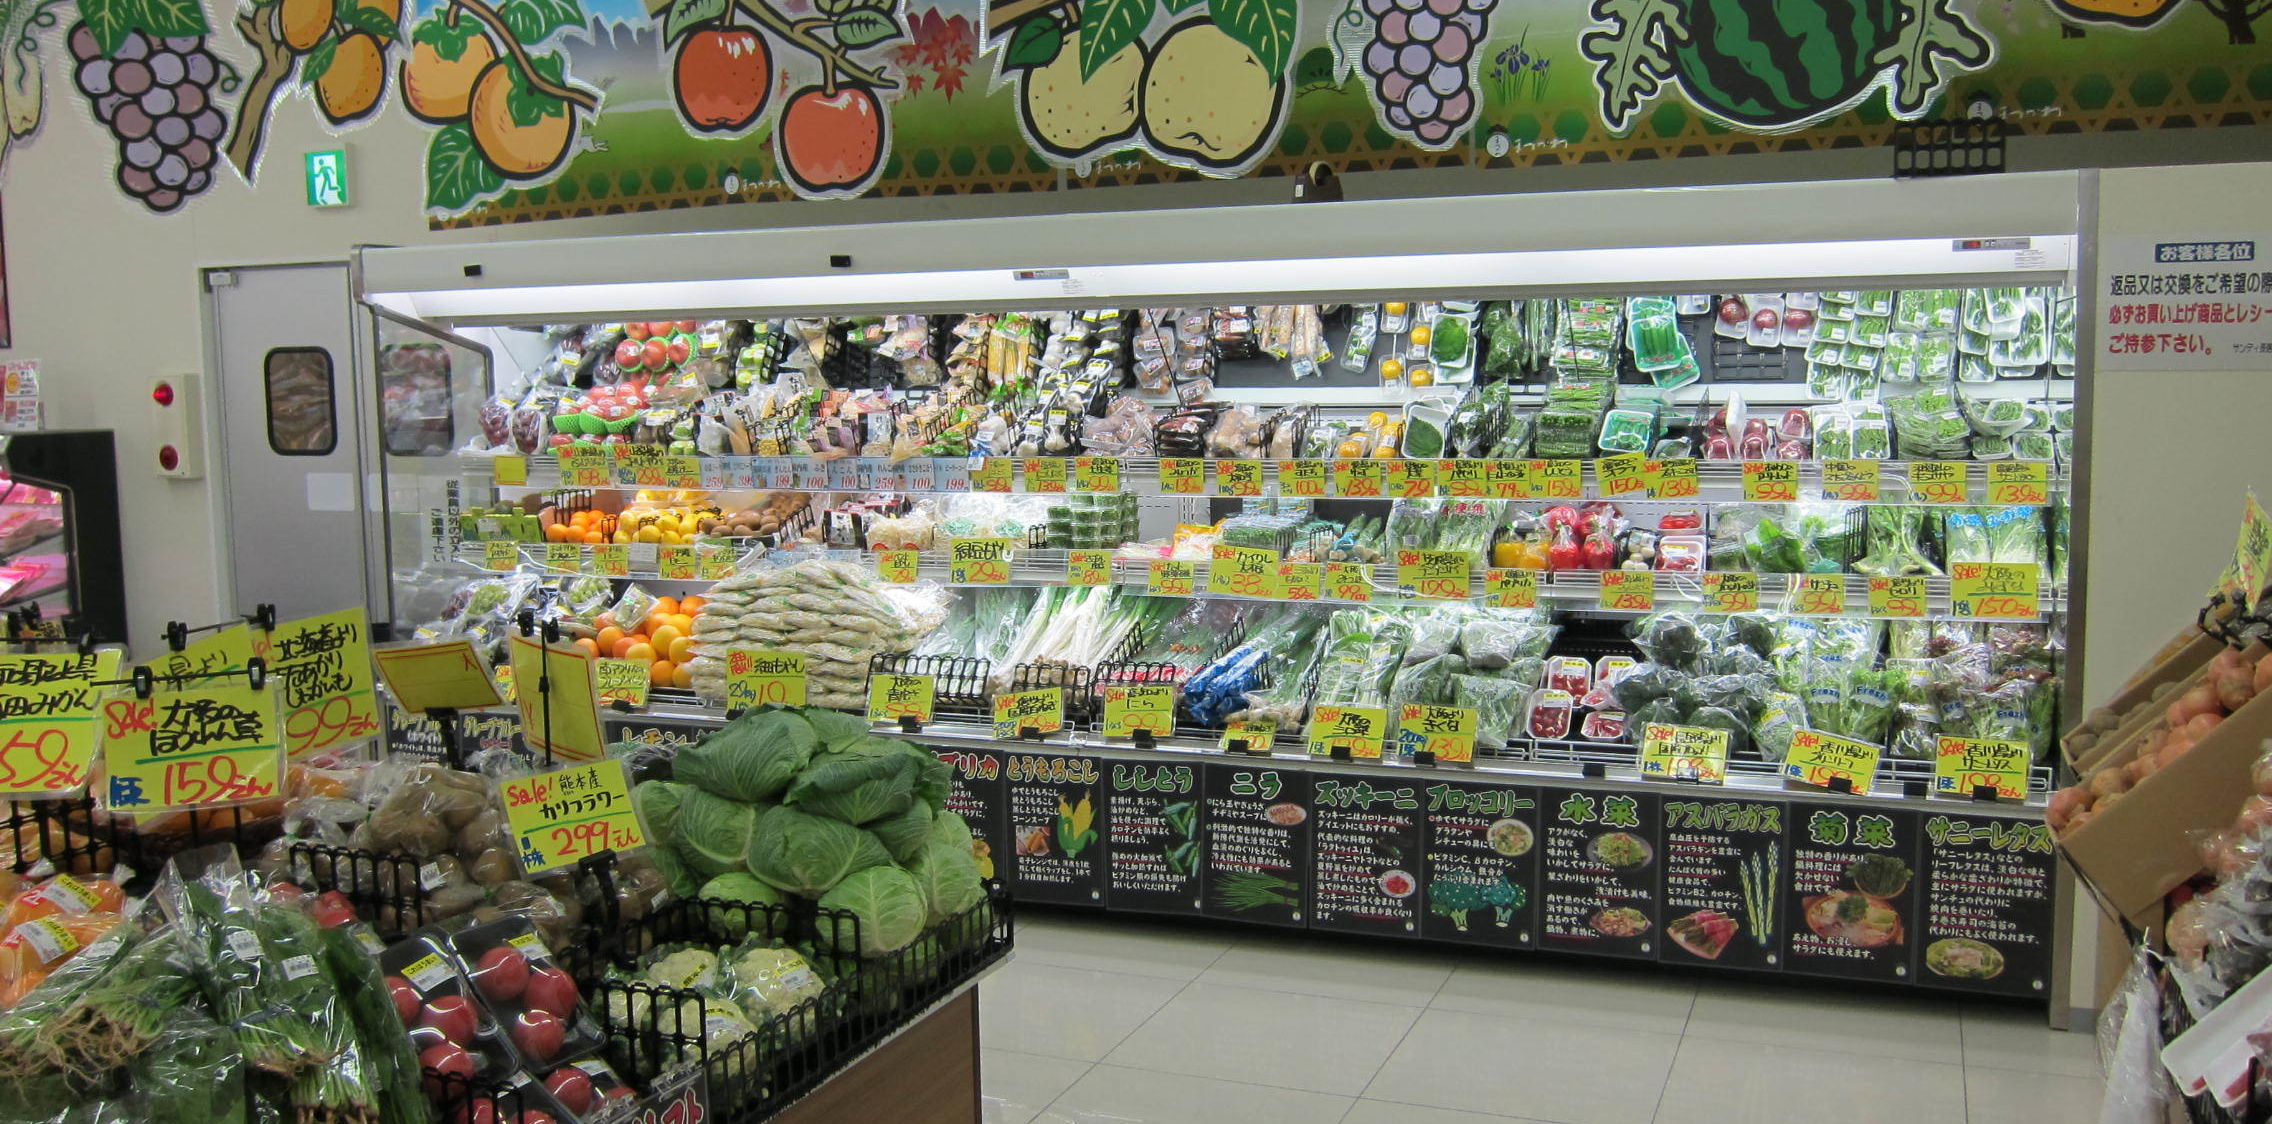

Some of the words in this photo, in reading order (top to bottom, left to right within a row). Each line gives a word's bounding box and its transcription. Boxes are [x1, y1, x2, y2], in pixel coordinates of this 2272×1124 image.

[2160, 243, 2251, 261] お客様各位
[2108, 333, 2212, 355] ご持参下さい。
[1006, 755, 1100, 785] とうもろこし
[1112, 764, 1194, 794] ししとう
[558, 766, 603, 796] 熊本産
[1230, 771, 1283, 800] ニラ
[507, 776, 553, 808] Sale!
[1314, 780, 1419, 810] ズッキーニ
[1426, 783, 1536, 818] ブロッコリー
[539, 791, 625, 820] カリフラワー
[1558, 792, 1640, 828] 水菜
[1013, 815, 1051, 824] コーンスープ
[1664, 801, 1782, 835] アスパラガス
[1317, 832, 1373, 844] 代表的な料理の
[1435, 826, 1473, 837] グラタンや
[1668, 833, 1730, 844] 高血圧を予防する
[1808, 810, 1896, 849] 菊菜
[1925, 816, 2053, 855] サニーレタス
[1546, 847, 1581, 858] 味わいを
[1547, 838, 1574, 847] 淡白な
[1668, 844, 1742, 856] アスパラギンを豊富に
[1317, 852, 1400, 866] ズッキーニやトマトなどの
[1794, 859, 1842, 872] 鍋料理には
[1794, 871, 1840, 883] 欠かせない
[1930, 893, 2011, 908] サンチュの代わりに
[1316, 911, 1334, 921] ます。
